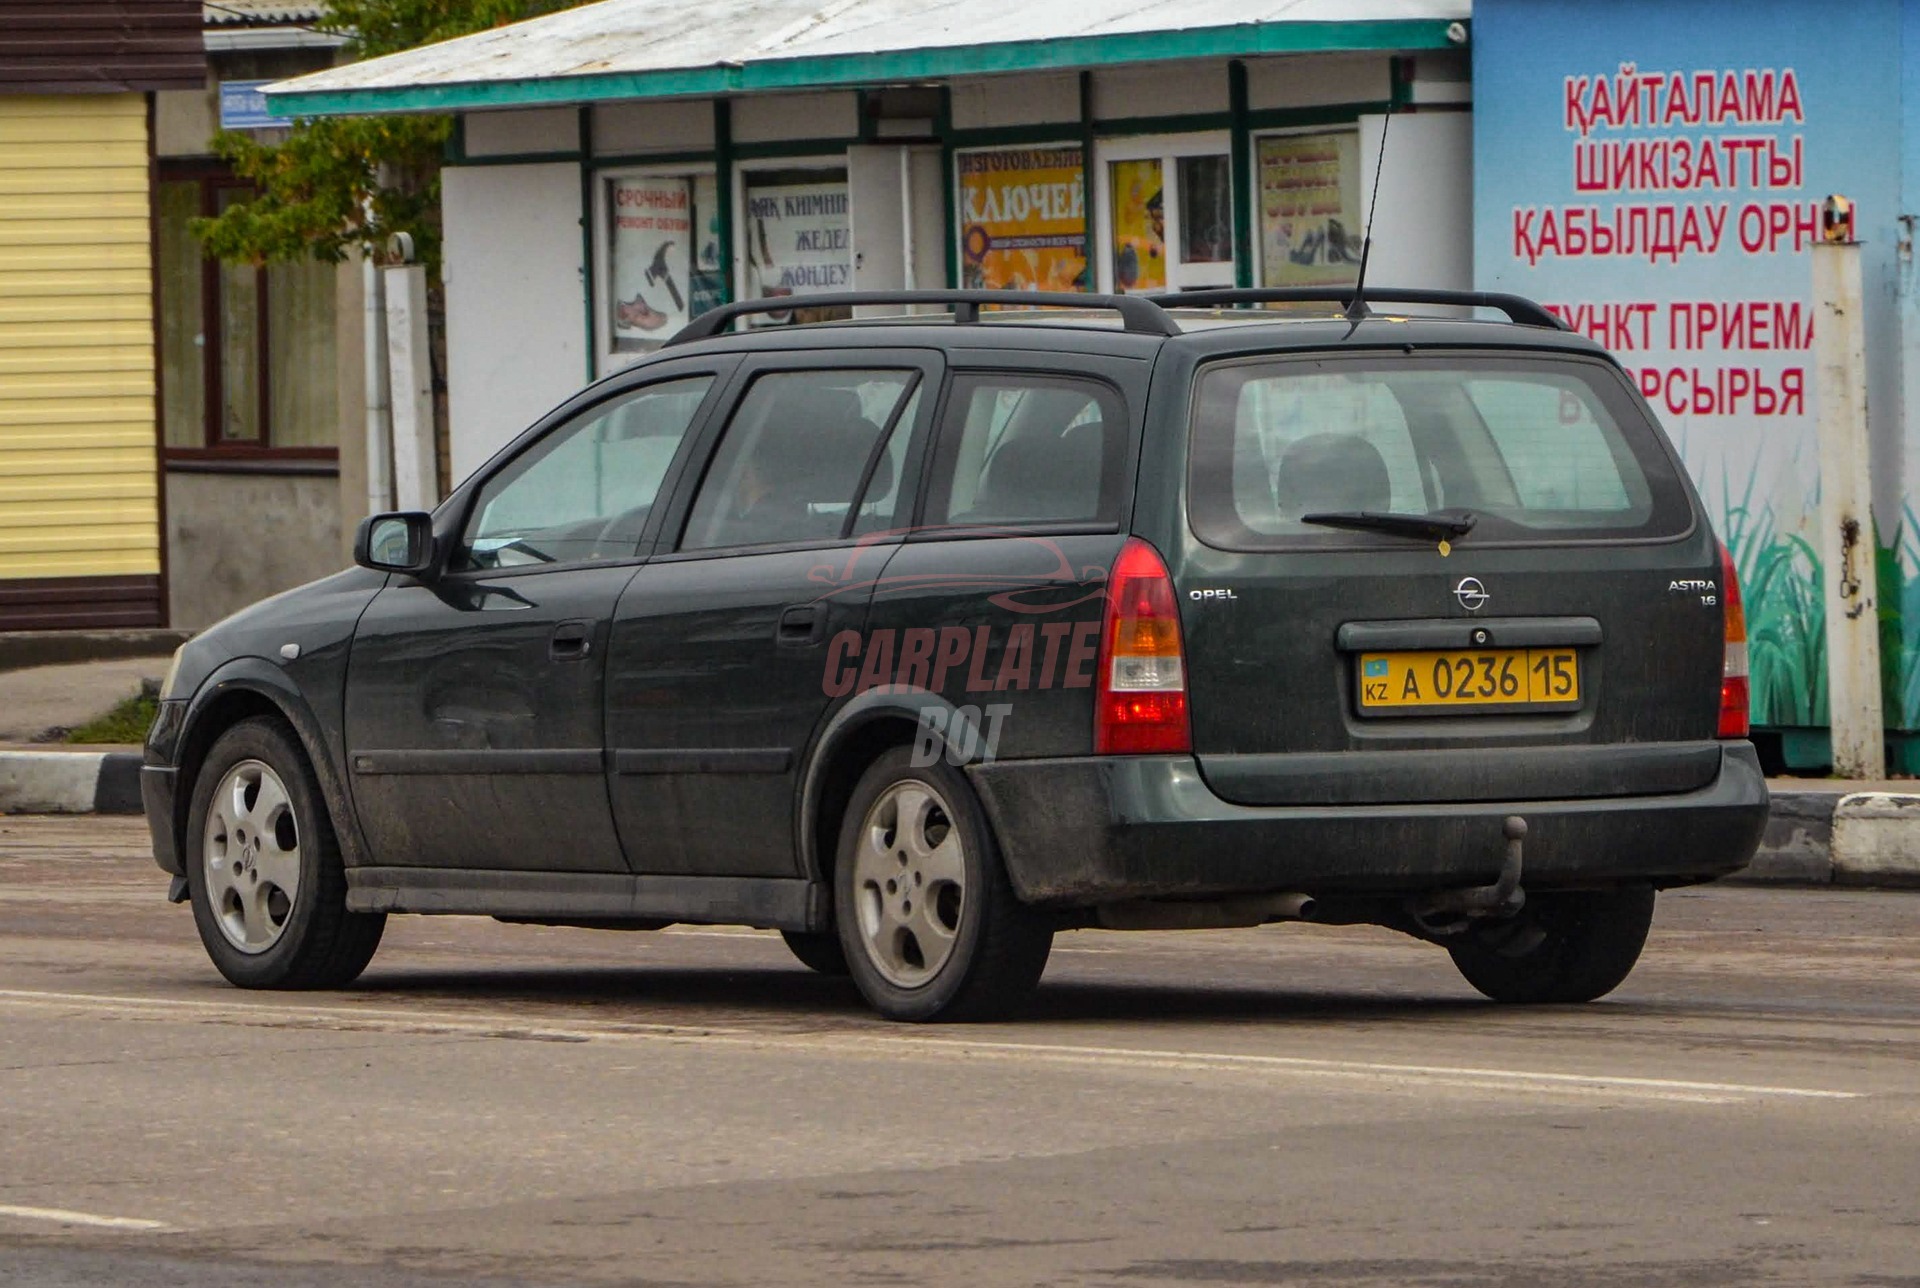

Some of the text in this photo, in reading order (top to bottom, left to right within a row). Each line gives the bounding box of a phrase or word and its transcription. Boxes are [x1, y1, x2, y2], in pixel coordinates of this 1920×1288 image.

[1565, 65, 1803, 135] ҚАЙТАЛАМА
[1575, 139, 1802, 191] ШИКІЗАТТЫ
[963, 174, 1084, 223] КЛЮЧЕЙ
[1514, 204, 1727, 266] ҚАБЫЛДАУ
[1189, 589, 1238, 601] OPEL
[1668, 580, 1717, 591] ASTRA
[1365, 655, 1573, 701] KZ A 0236 15
